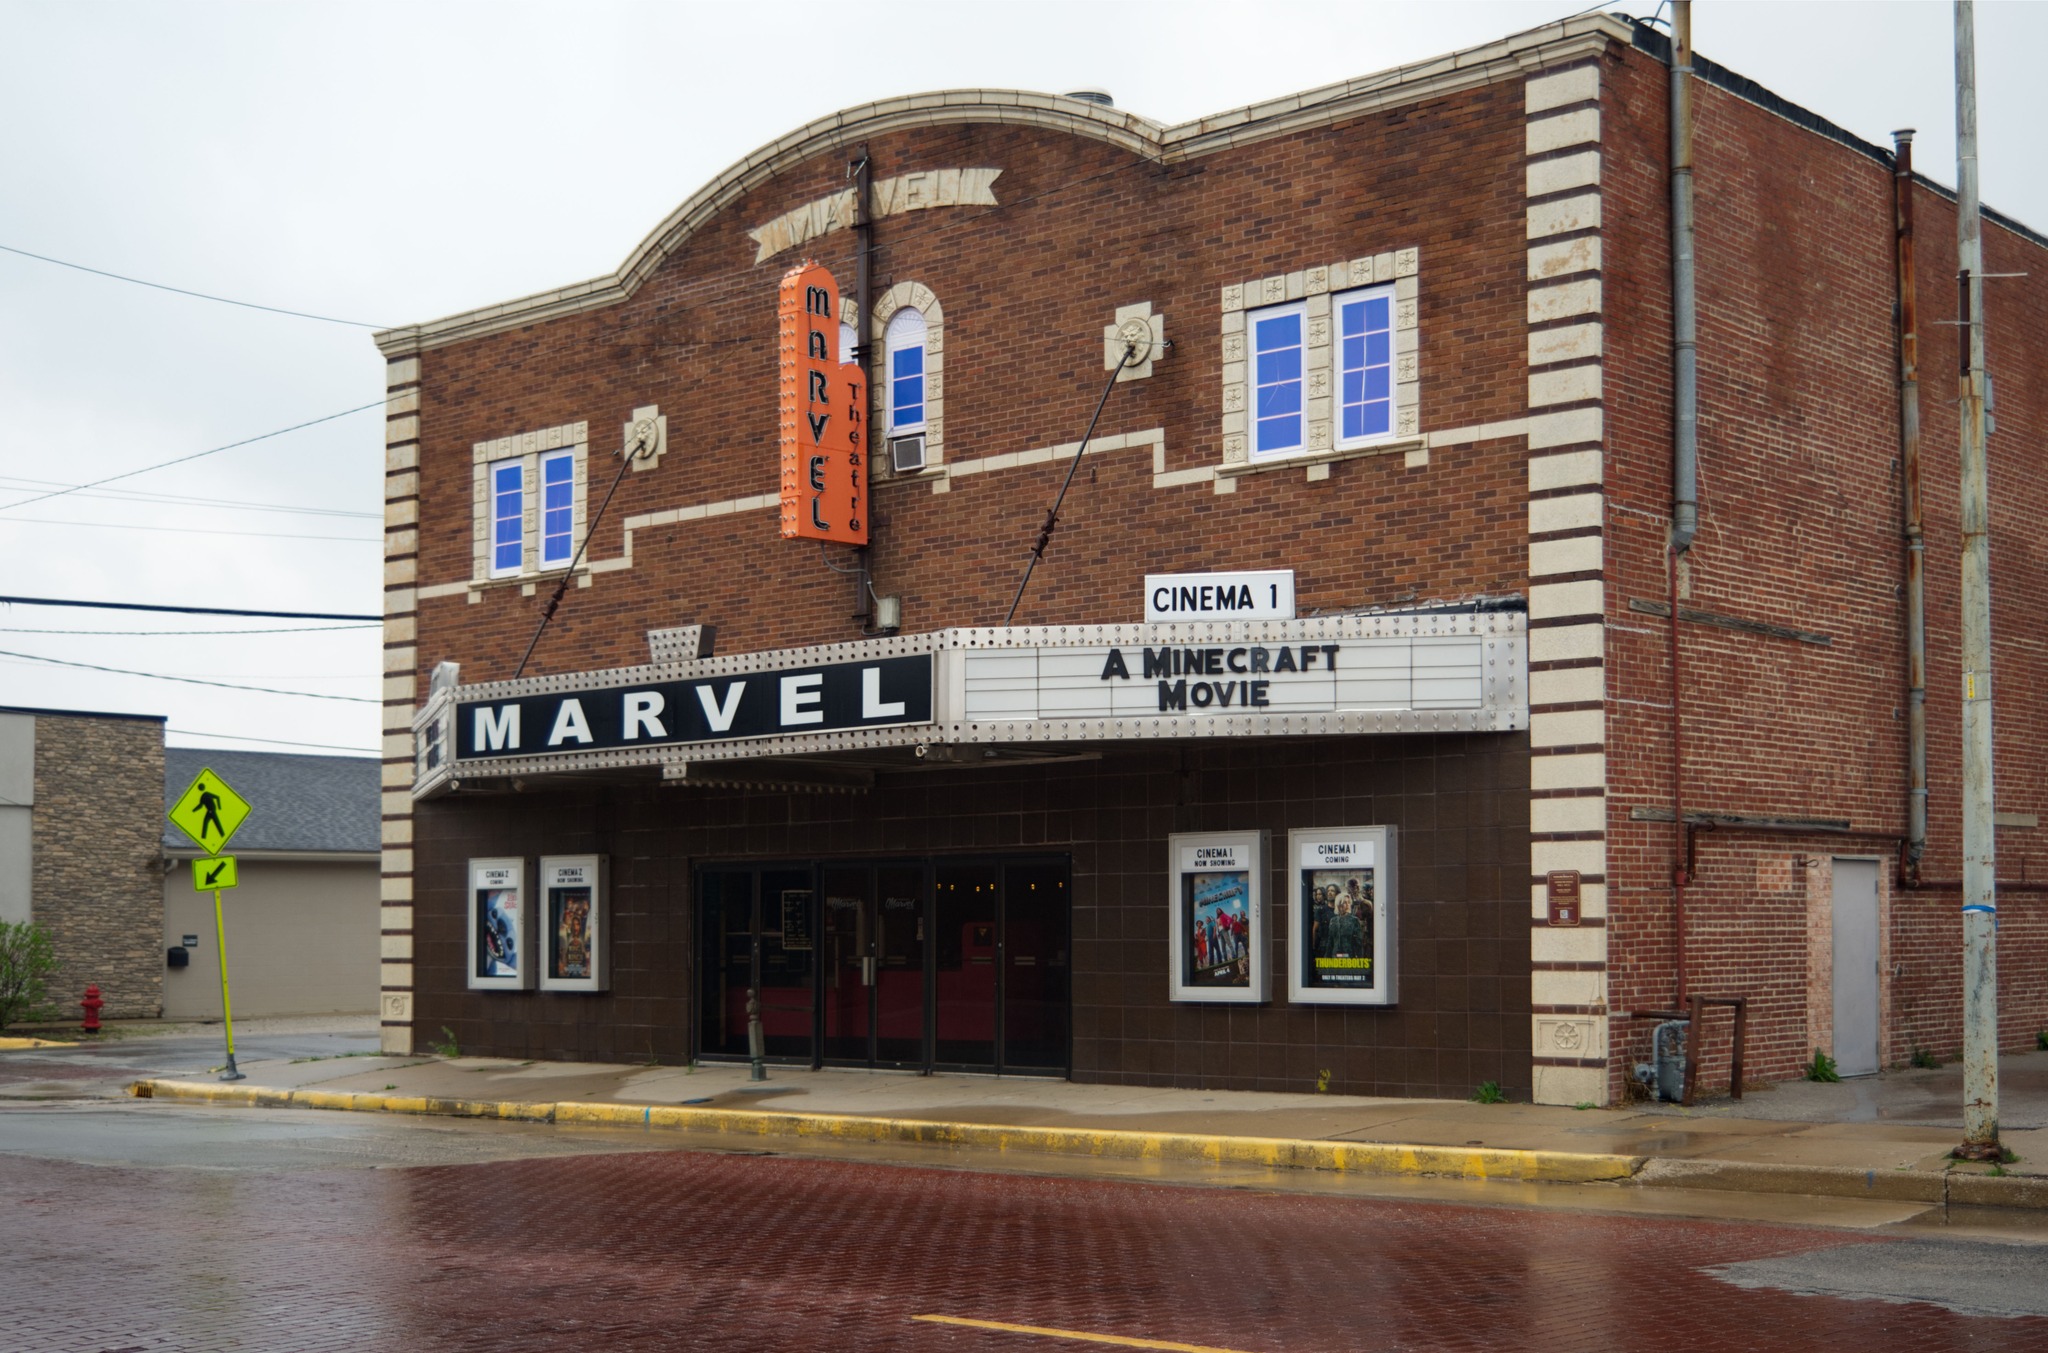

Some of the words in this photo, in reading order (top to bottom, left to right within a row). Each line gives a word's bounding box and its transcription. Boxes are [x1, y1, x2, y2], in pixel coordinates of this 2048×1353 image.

[806, 285, 832, 531] MARVEL
[847, 382, 862, 531] Theatre
[1153, 584, 1254, 612] CINEMA
[1270, 584, 1277, 609] 1
[1101, 648, 1130, 680] A
[1143, 645, 1340, 679] MINECRAFT
[1158, 679, 1270, 711] MOVIE
[474, 667, 906, 752] MARVEL
[1197, 848, 1227, 858] CINEMA
[1318, 844, 1351, 854] CINEMA
[1210, 859, 1235, 867] SHOWING
[1325, 856, 1349, 864] COMING
[486, 870, 504, 878] CINEMA
[558, 868, 578, 876] CINEMA
